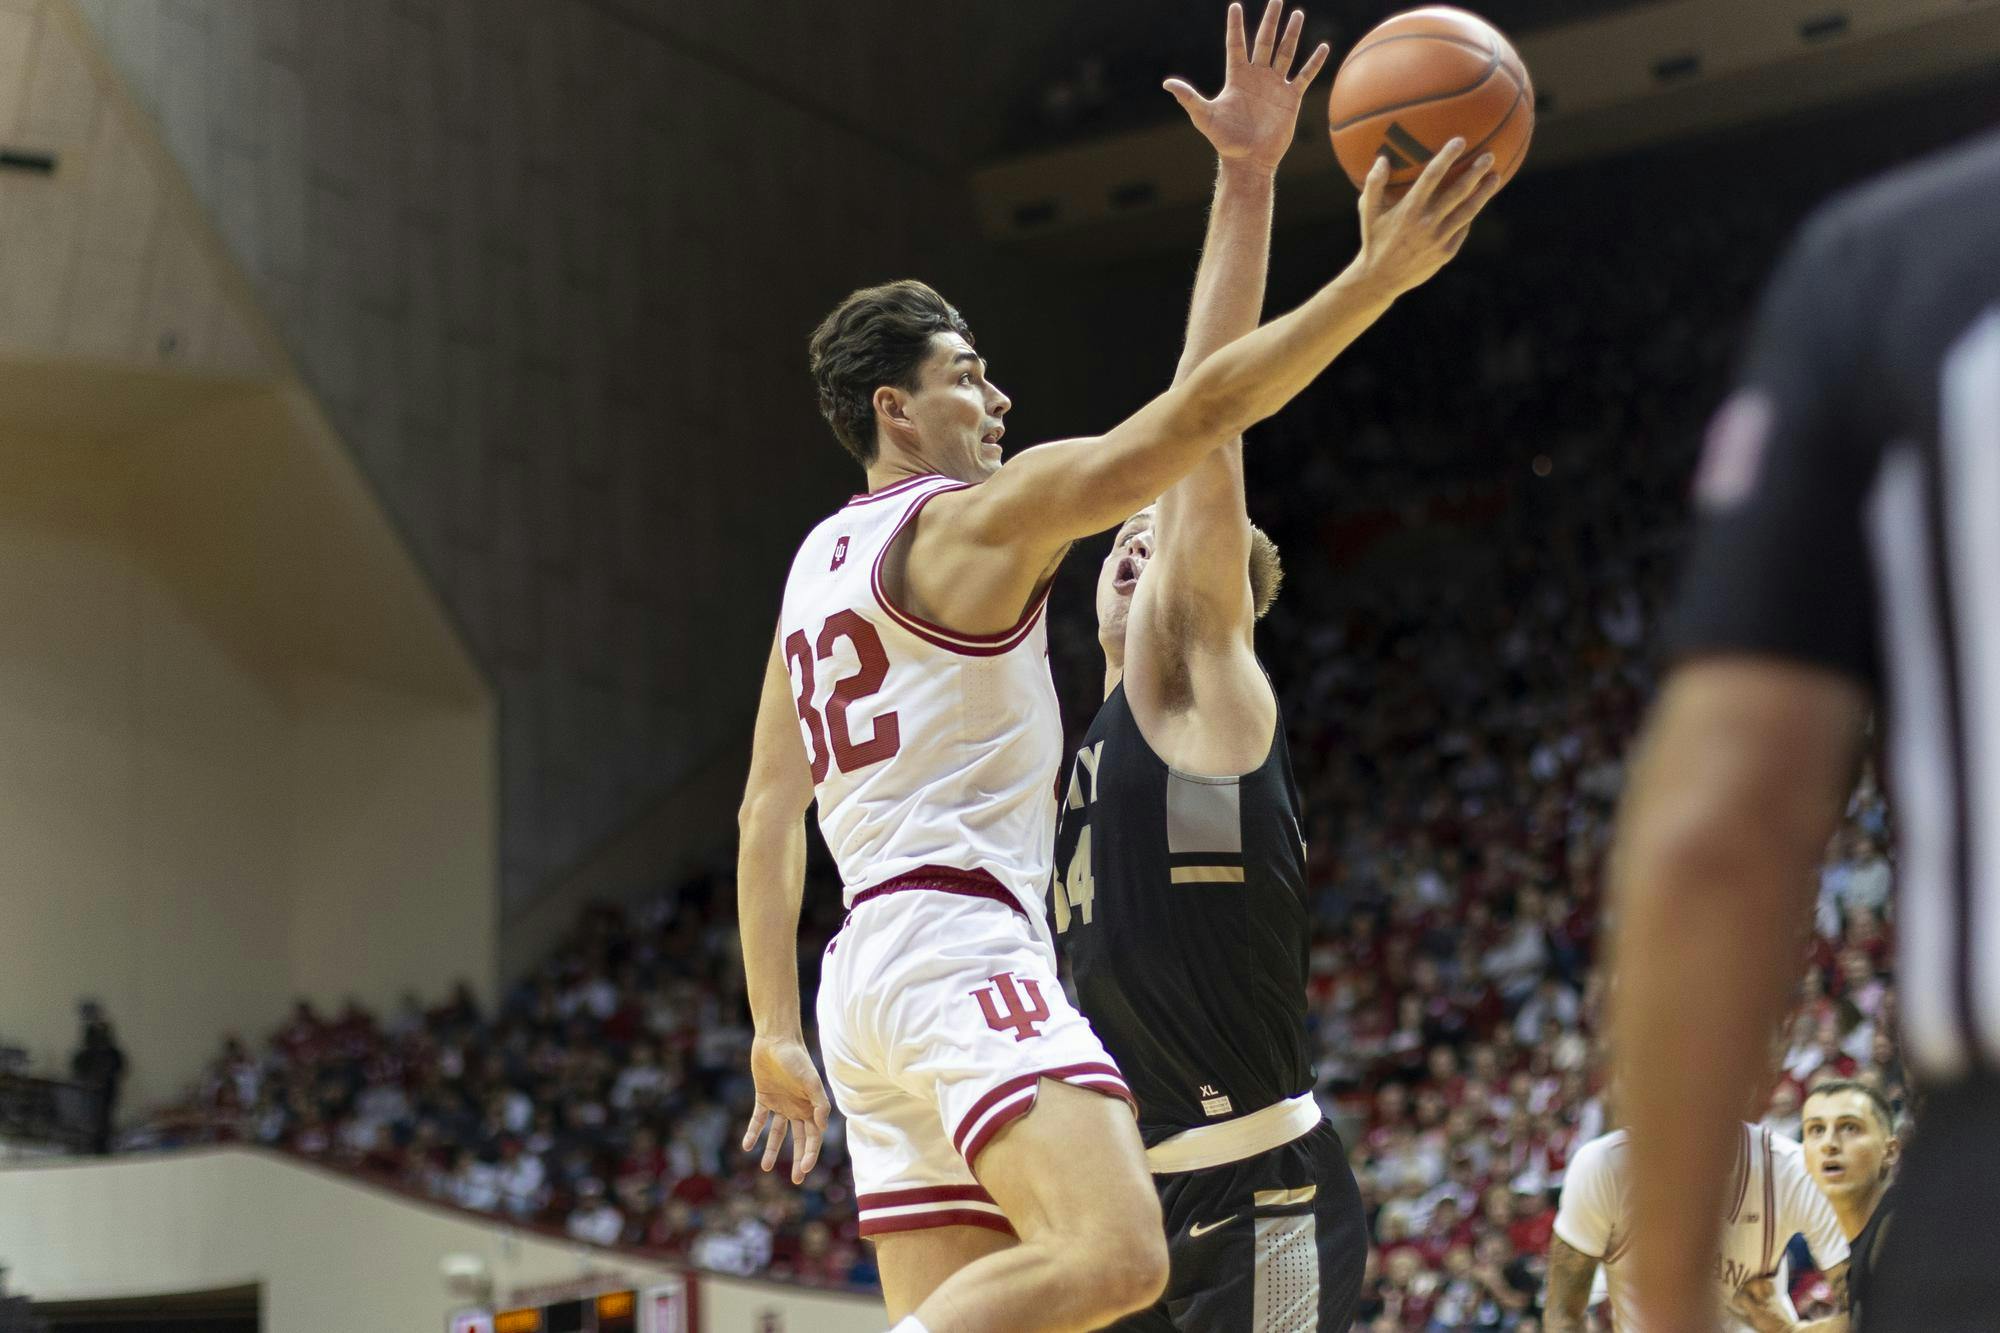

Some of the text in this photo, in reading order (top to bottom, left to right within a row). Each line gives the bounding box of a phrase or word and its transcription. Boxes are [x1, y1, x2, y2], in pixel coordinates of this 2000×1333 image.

[785, 608, 901, 785] 32
[968, 971, 1051, 1042] IU
[1200, 1084, 1219, 1097] XL
